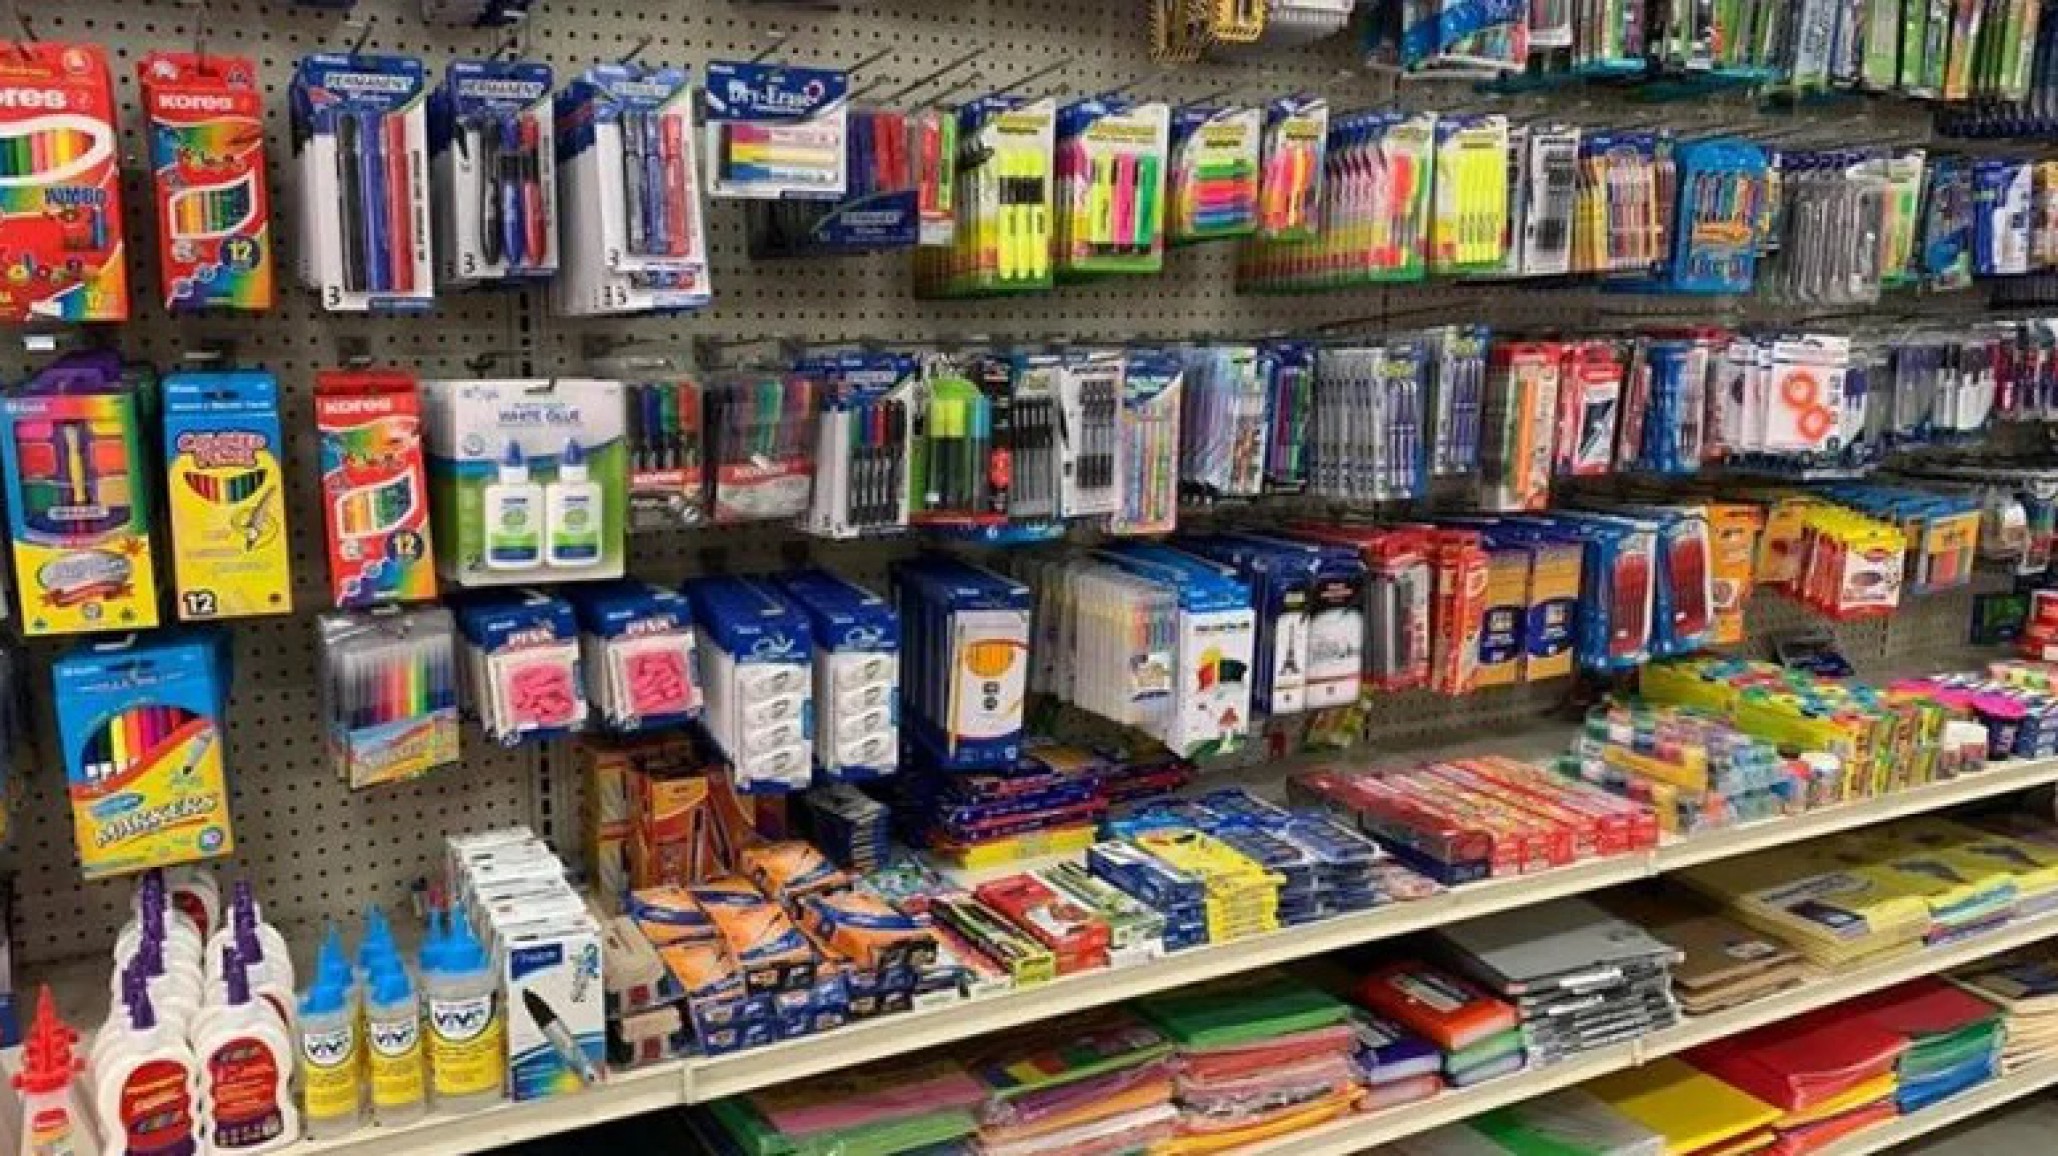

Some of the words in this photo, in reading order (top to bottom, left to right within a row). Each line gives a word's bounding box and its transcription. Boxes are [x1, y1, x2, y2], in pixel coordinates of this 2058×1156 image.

[228, 243, 252, 260] 12
[327, 286, 341, 306] 3
[186, 592, 214, 614] 12
